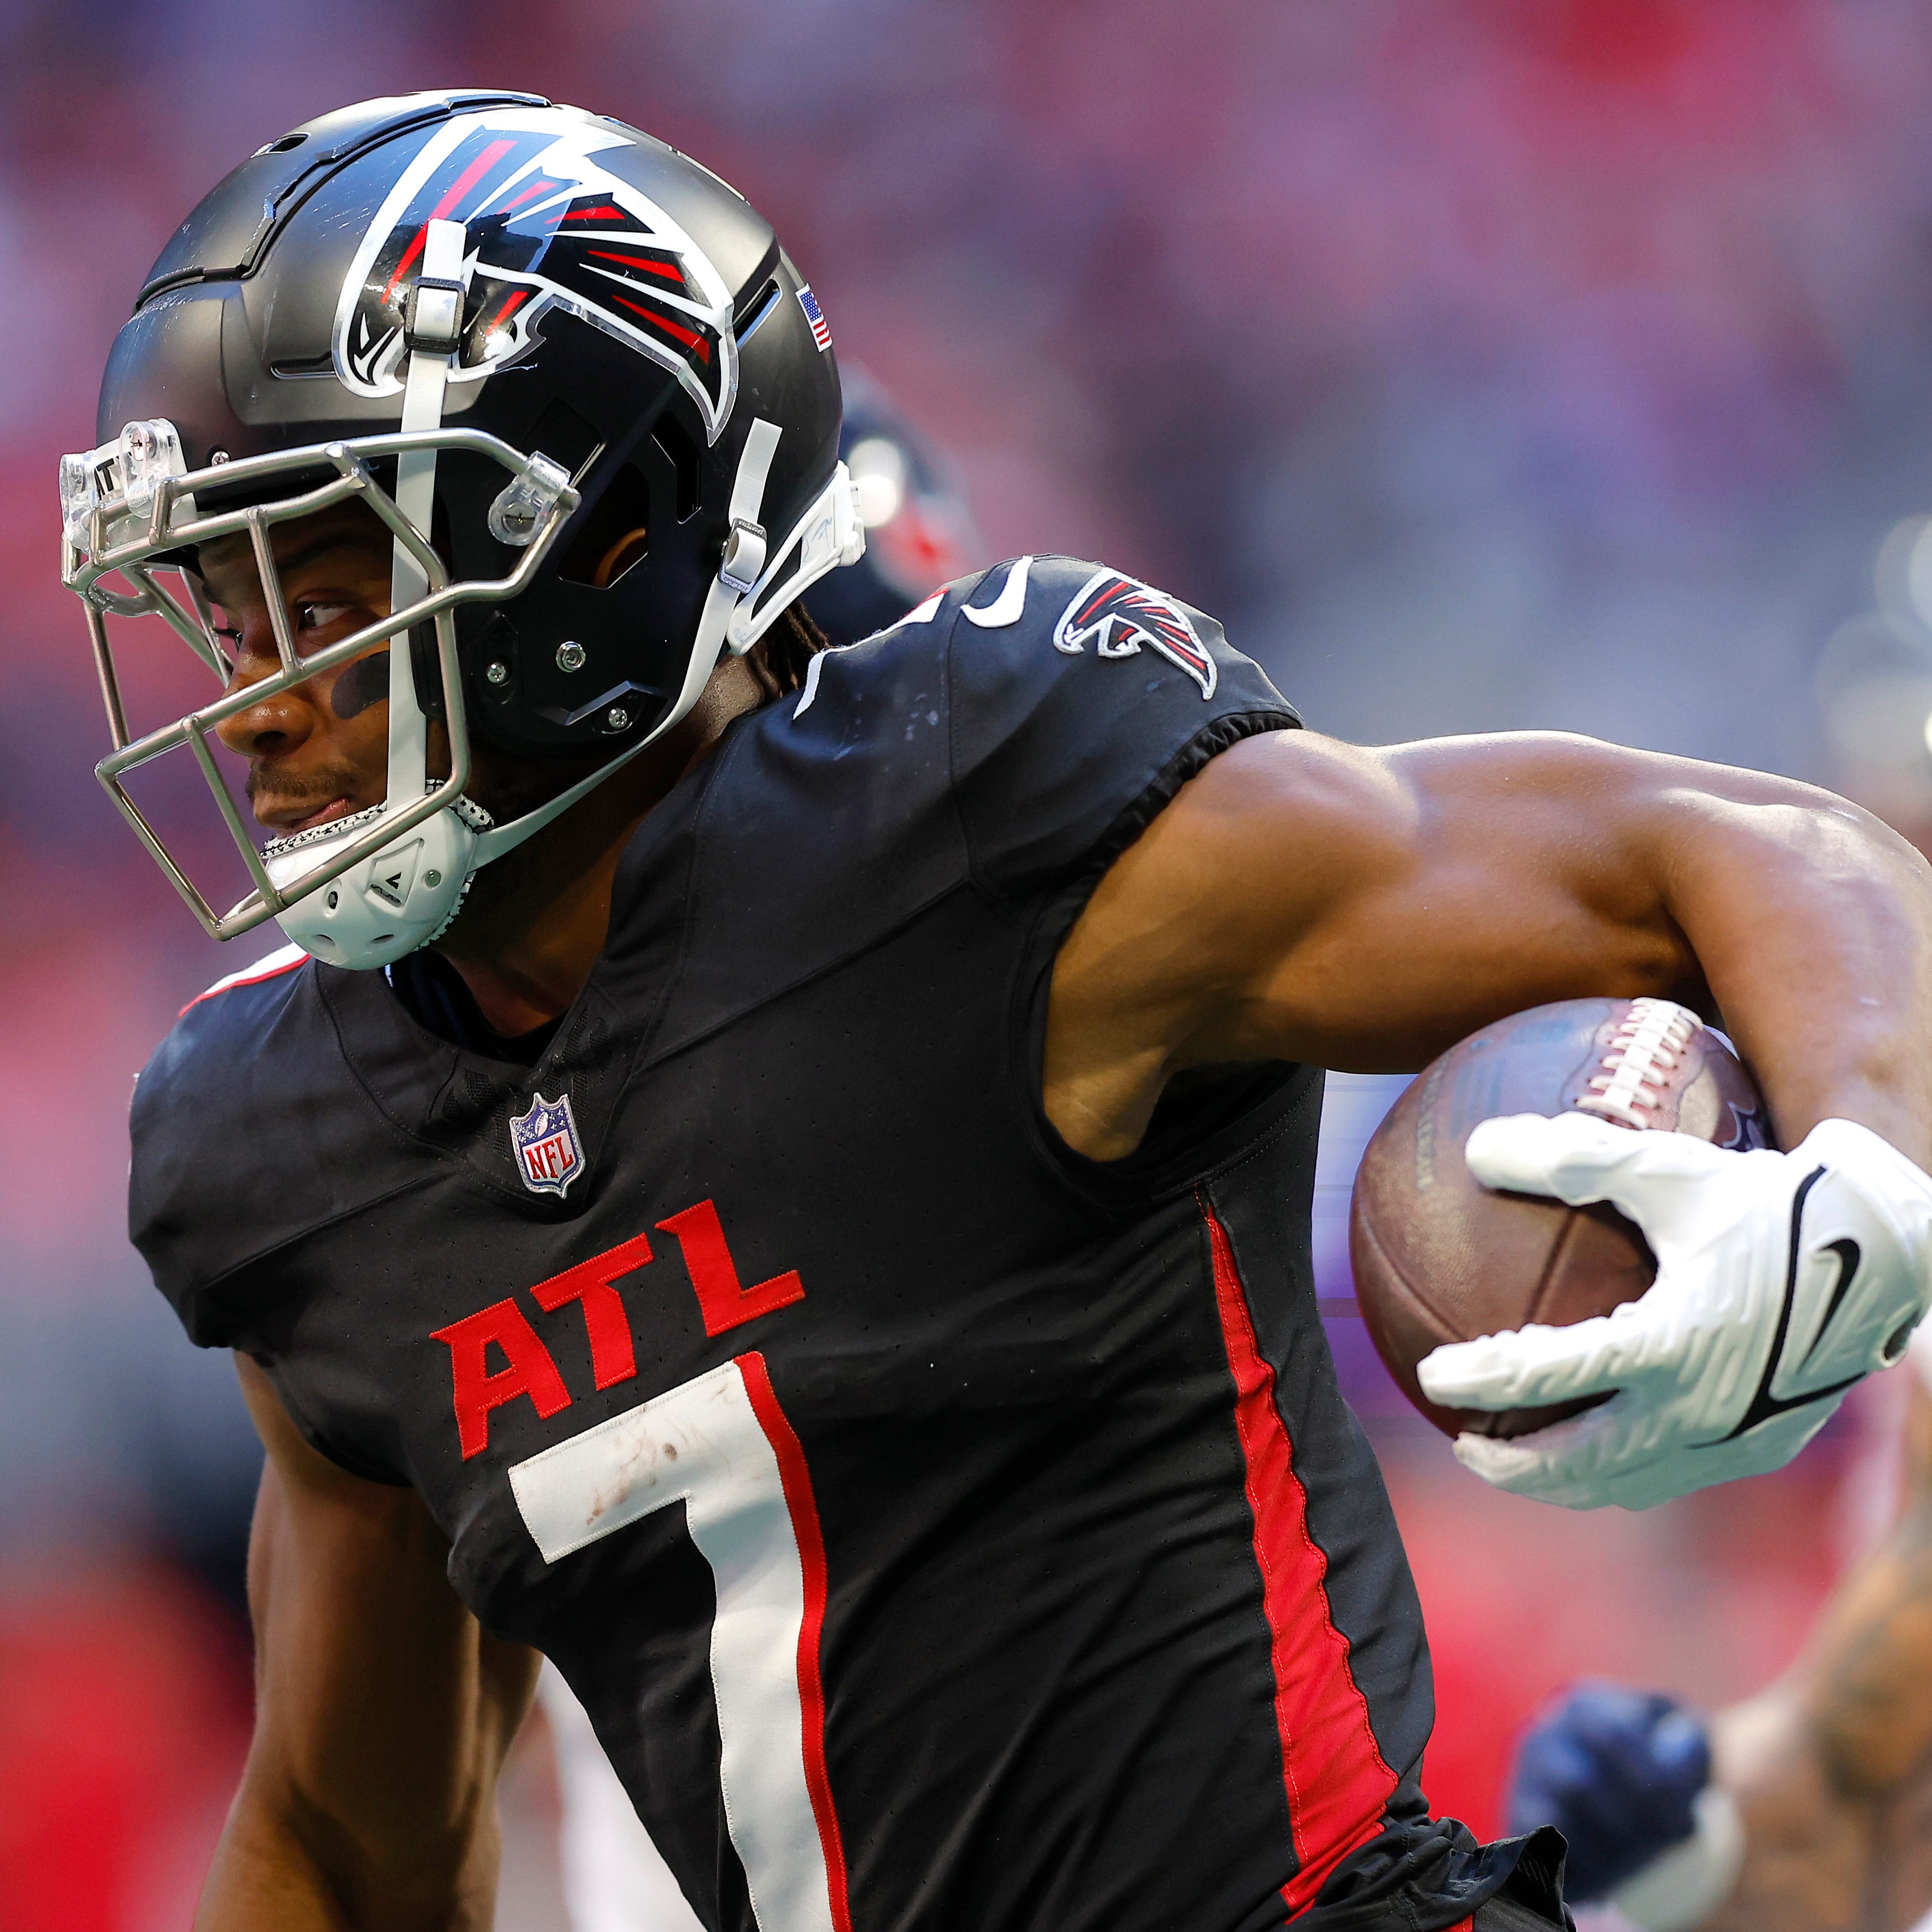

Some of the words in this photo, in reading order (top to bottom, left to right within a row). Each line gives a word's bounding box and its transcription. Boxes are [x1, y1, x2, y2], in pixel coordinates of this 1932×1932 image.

[526, 1136, 574, 1180] NFL
[430, 1199, 805, 1461] ATL
[508, 1351, 850, 1932] 7
